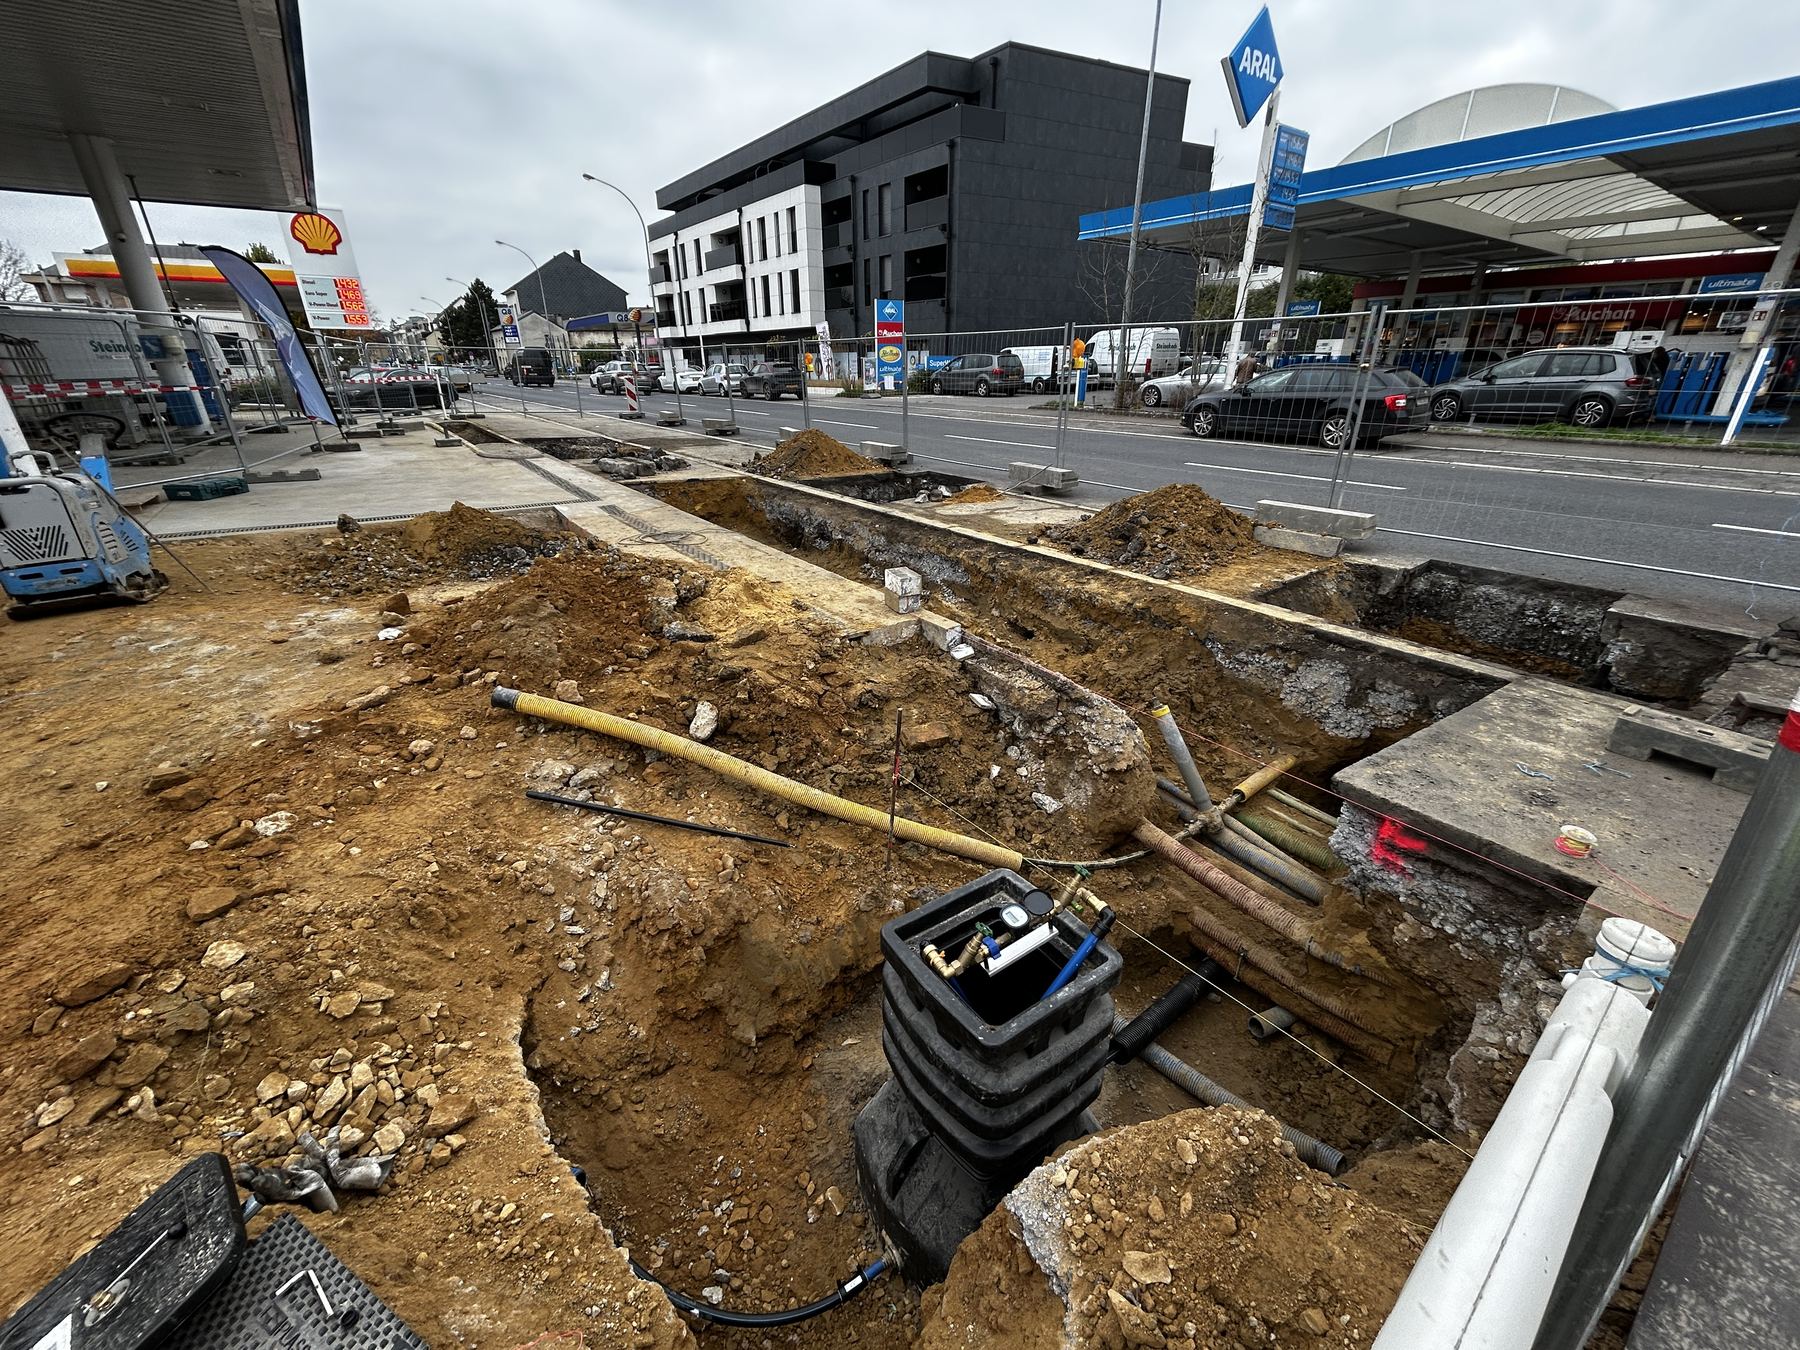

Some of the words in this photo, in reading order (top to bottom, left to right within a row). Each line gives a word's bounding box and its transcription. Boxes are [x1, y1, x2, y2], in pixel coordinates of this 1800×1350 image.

[1239, 46, 1277, 84] ARAL
[1707, 278, 1757, 288] ultimate
[616, 313, 629, 322] Q8
[1563, 306, 1636, 321] Auchan
